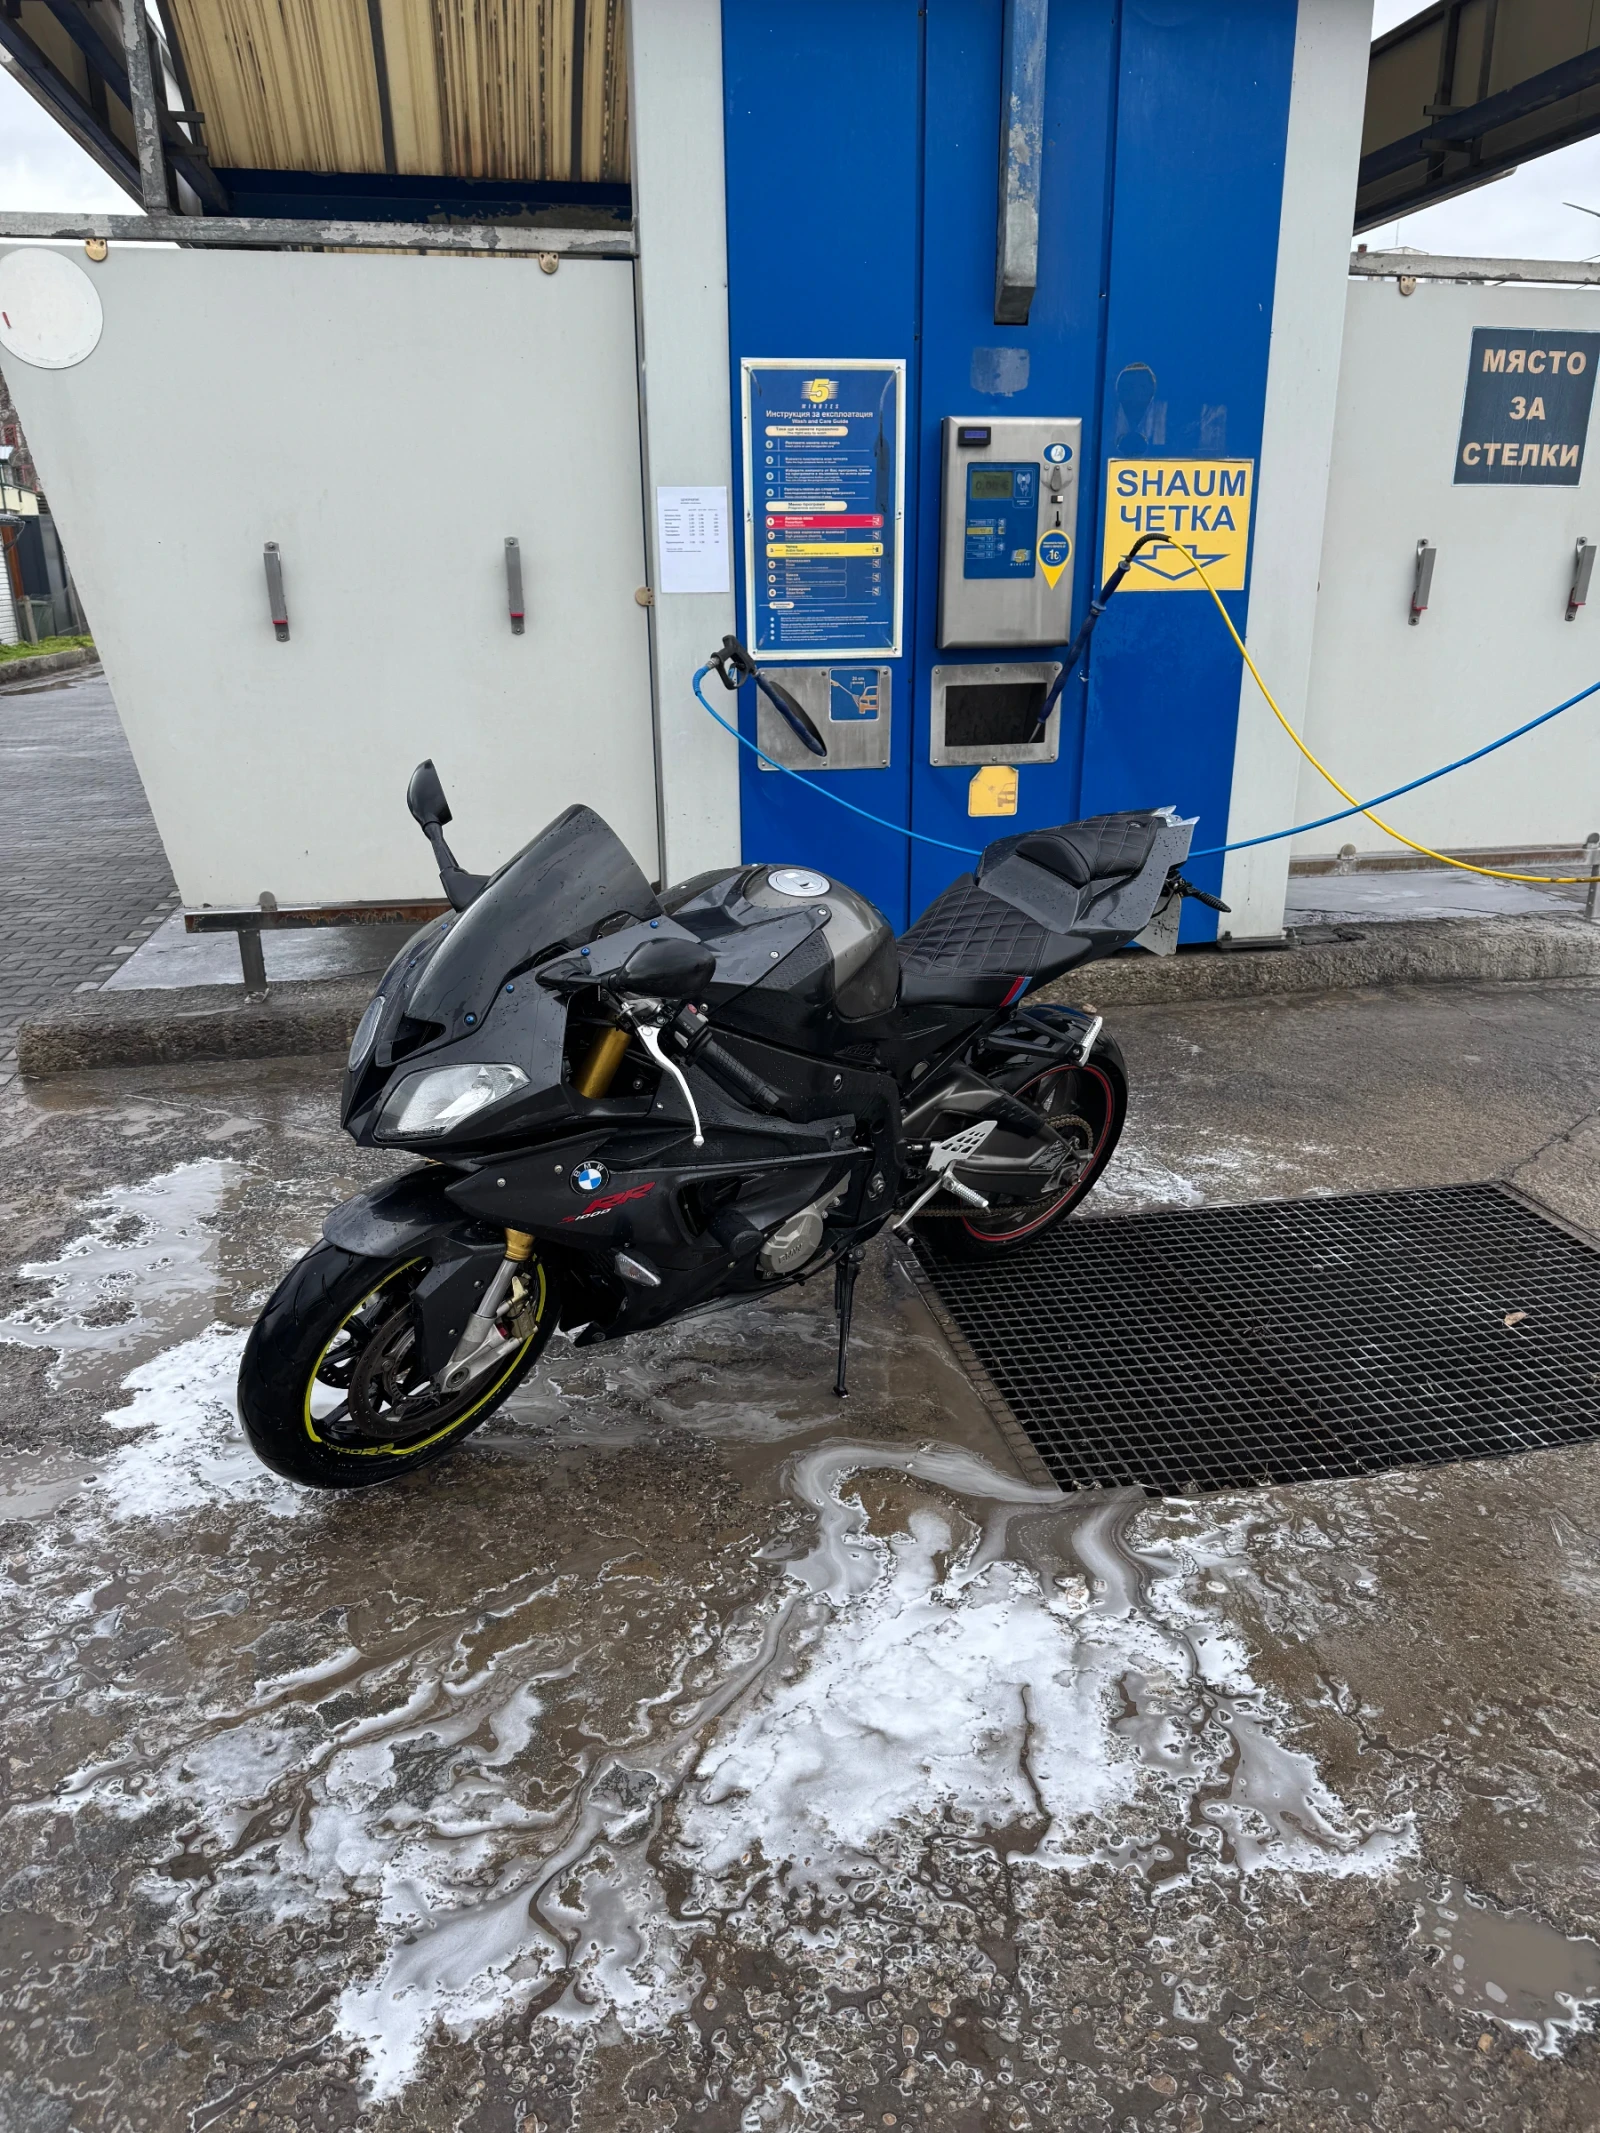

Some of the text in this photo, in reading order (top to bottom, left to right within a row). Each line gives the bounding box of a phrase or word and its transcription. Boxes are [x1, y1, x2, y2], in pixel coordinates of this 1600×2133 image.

[1482, 349, 1587, 375] МЯСТО
[809, 378, 830, 403] 5
[766, 410, 810, 418] Инструкция
[1509, 396, 1546, 421] ЗА
[1462, 442, 1579, 467] СТЕЛКИ
[1116, 469, 1246, 497] SHAUM
[1120, 505, 1236, 532] ЧЕТКА
[1015, 549, 1027, 563] 5
[573, 1163, 604, 1178] BMW
